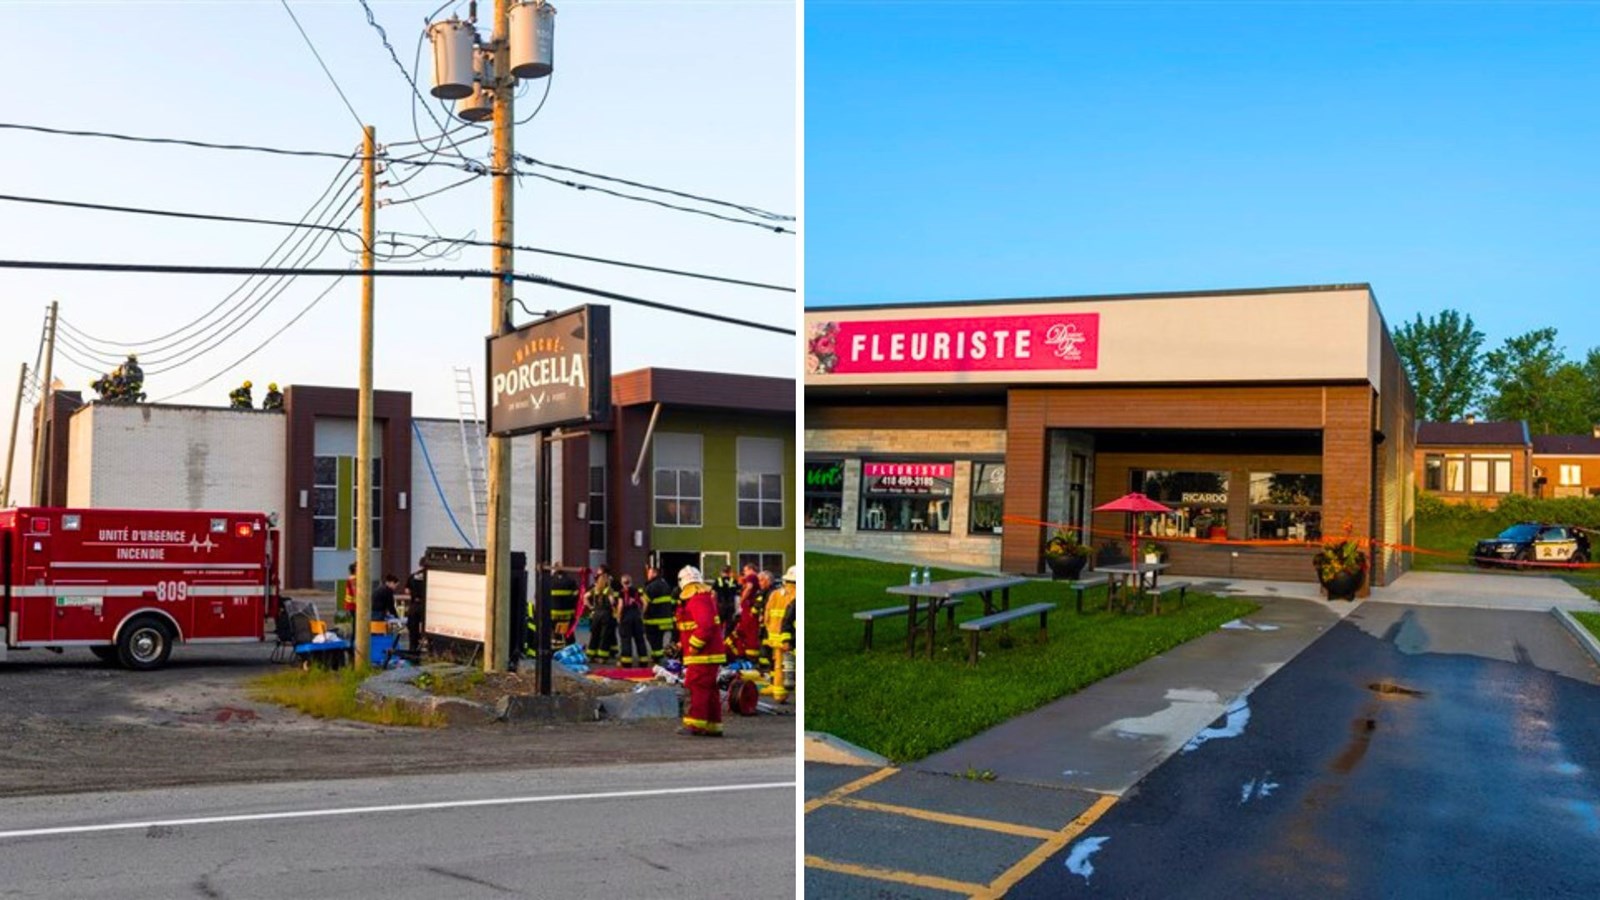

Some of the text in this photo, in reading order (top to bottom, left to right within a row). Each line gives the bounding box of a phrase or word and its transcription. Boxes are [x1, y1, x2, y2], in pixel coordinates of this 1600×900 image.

[851, 329, 1031, 362] FLEURISTE
[493, 353, 585, 407] PORCELLA
[872, 464, 946, 475] FLEURISTE
[1182, 492, 1228, 504] RICARDO
[99, 526, 186, 542] UNITÉ D'URGENCE
[117, 548, 165, 560] INCENDIE
[156, 581, 188, 602] 809
